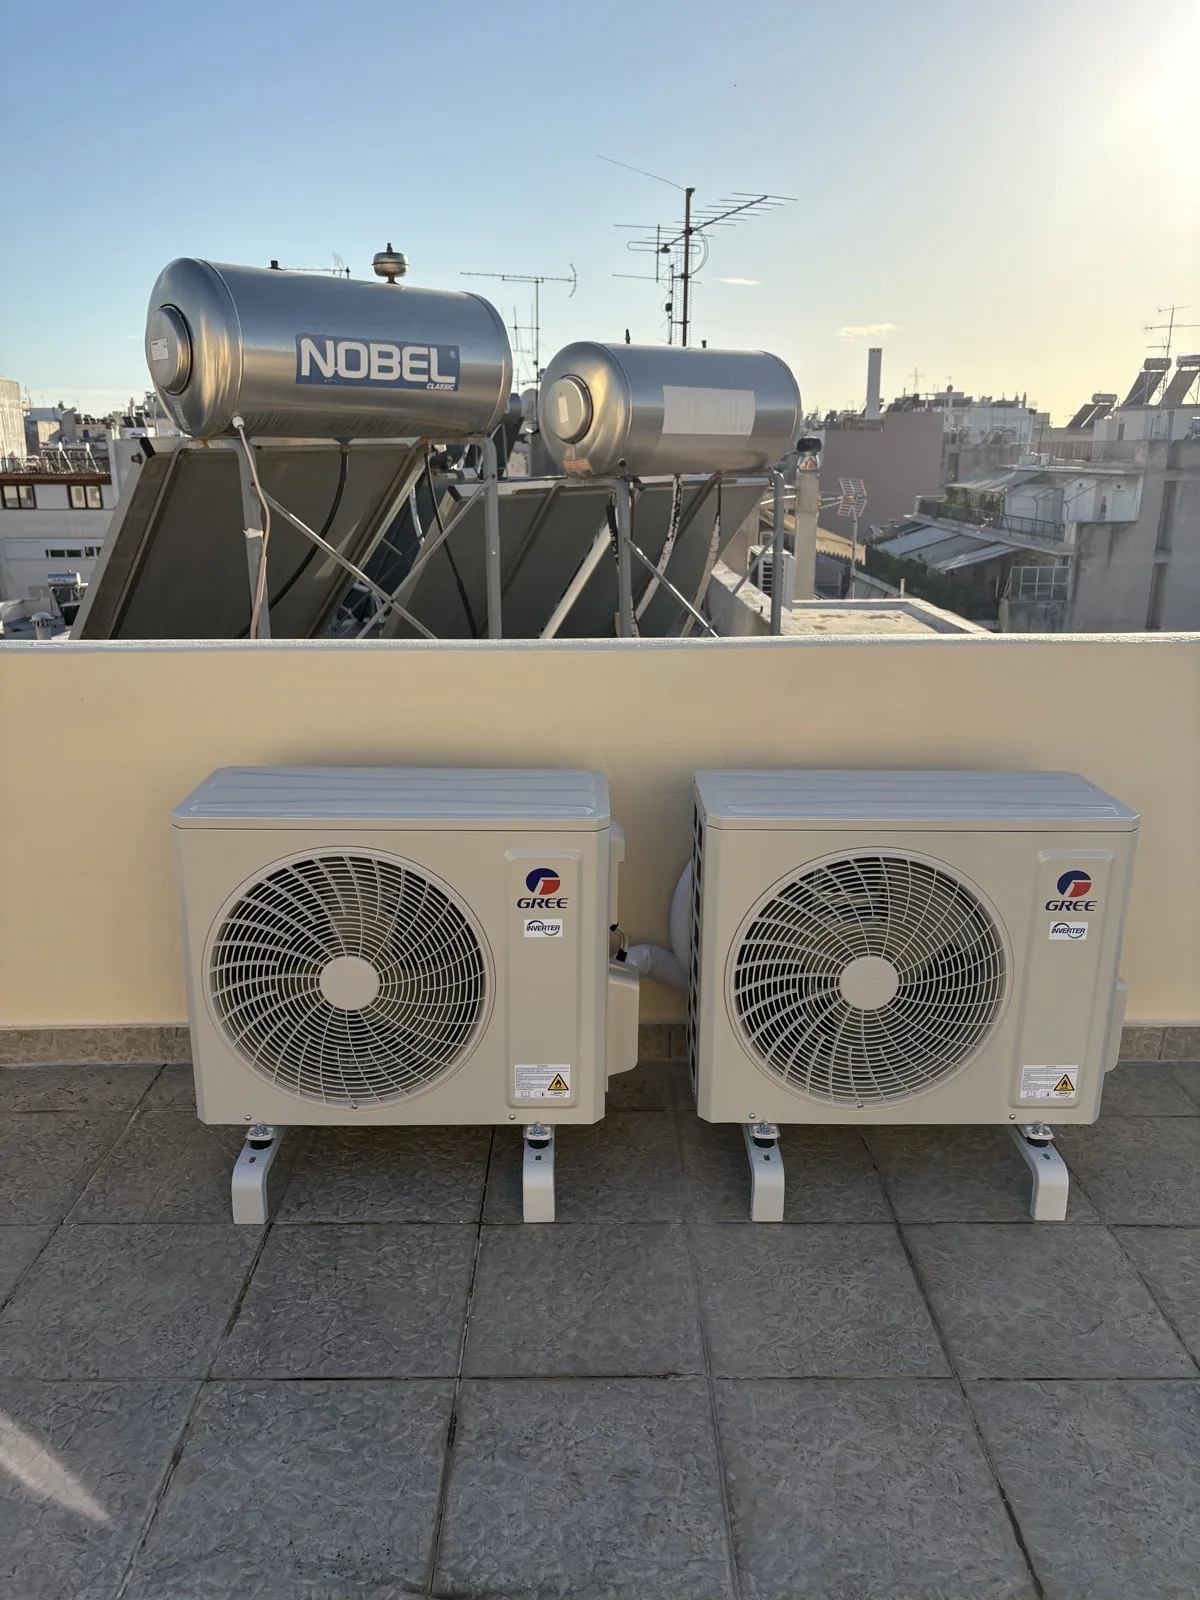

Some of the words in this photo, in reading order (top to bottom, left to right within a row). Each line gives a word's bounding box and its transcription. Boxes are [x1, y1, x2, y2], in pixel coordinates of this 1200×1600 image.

[301, 338, 456, 383] NOBEL
[426, 382, 455, 391] CLASSIC
[516, 897, 570, 909] GREE
[1045, 900, 1098, 912] GREE
[526, 924, 561, 932] INVERTER
